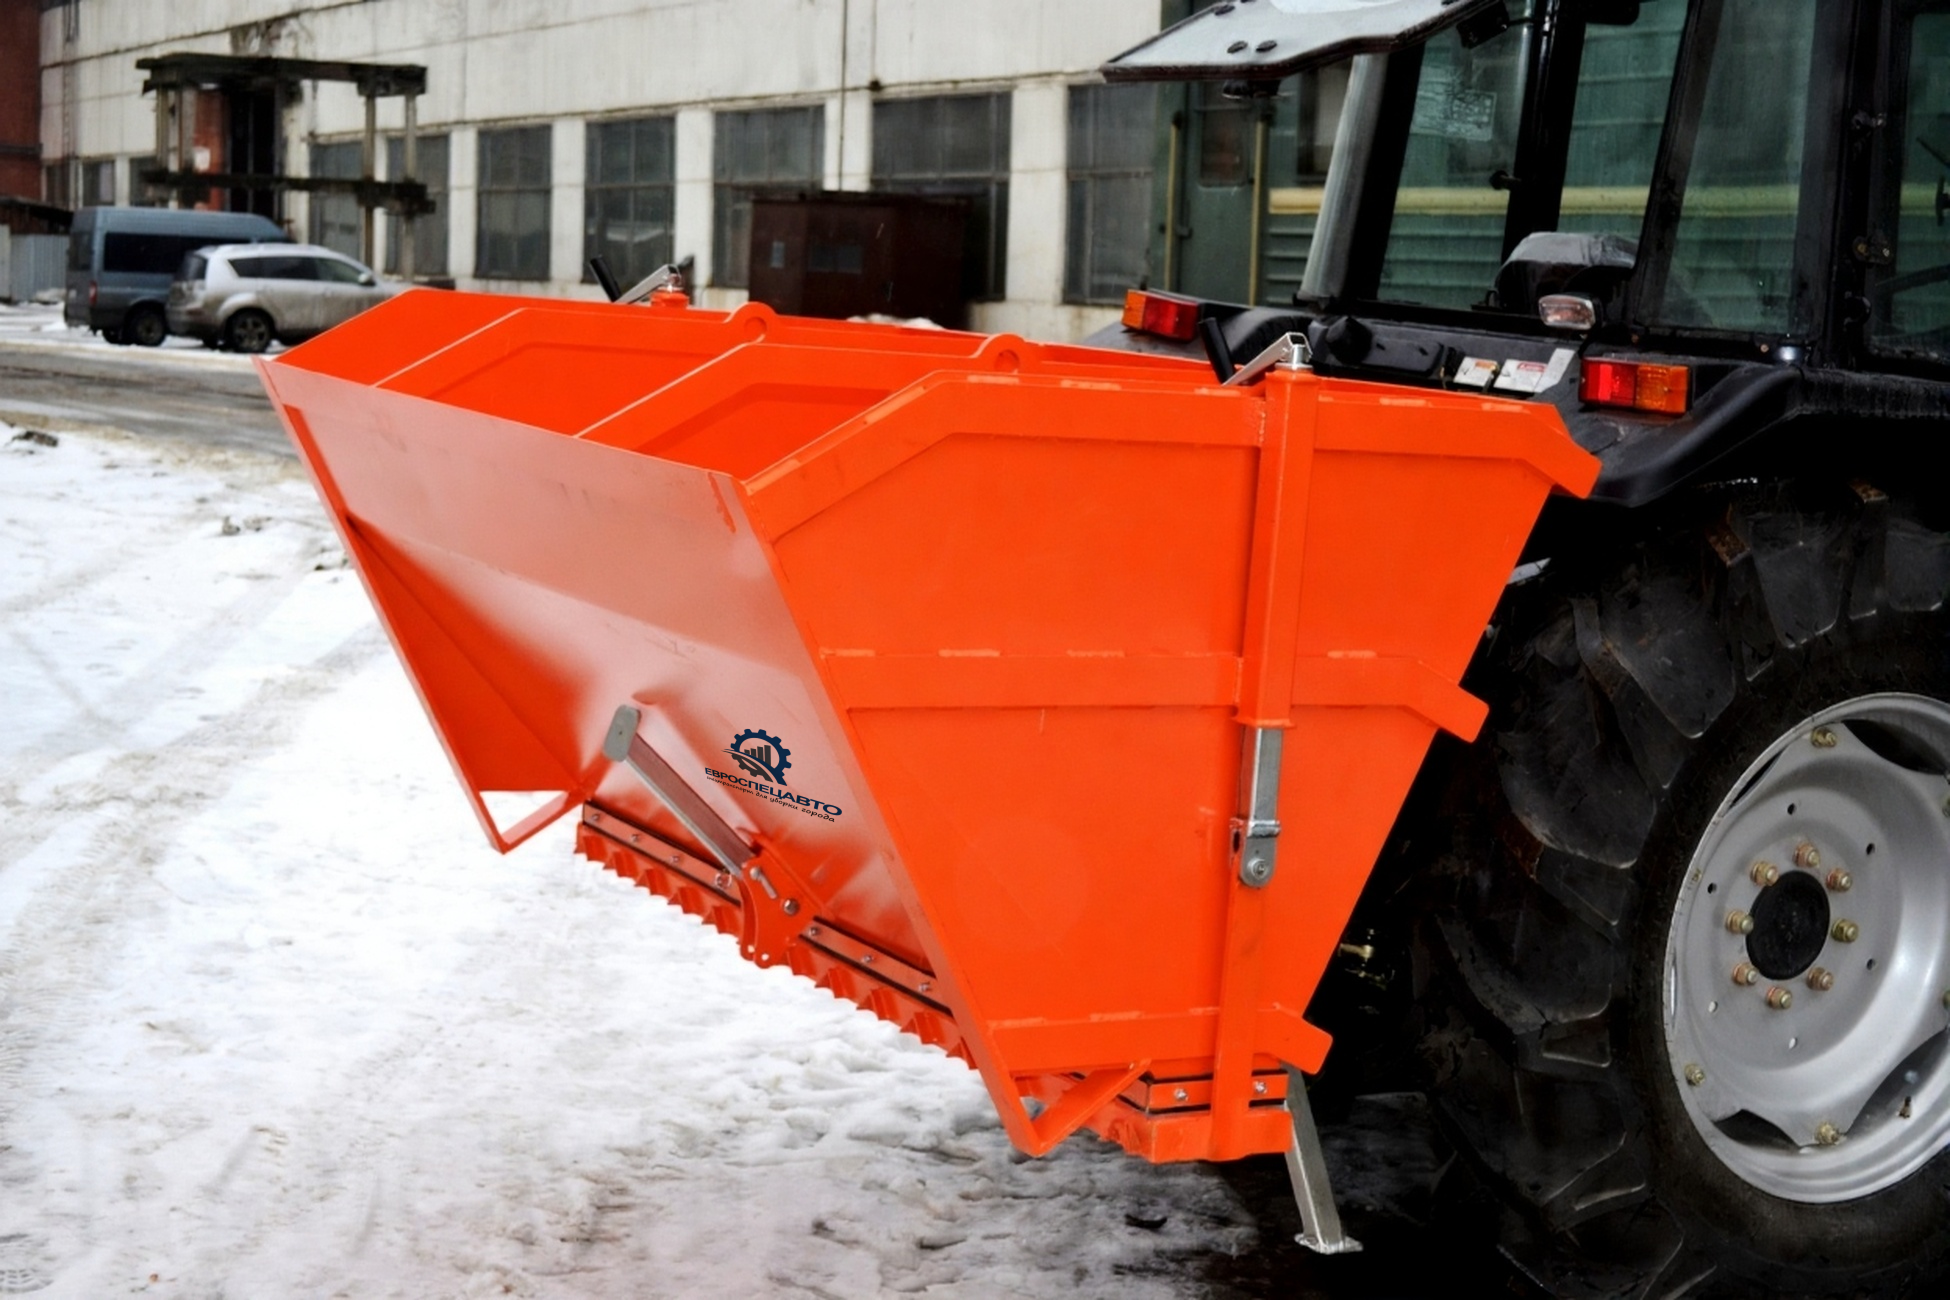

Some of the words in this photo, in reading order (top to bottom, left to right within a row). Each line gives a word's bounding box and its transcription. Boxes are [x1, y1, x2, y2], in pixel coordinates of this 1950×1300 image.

[705, 767, 843, 816] ЕВРОСПЕЦАВТО
[769, 797, 798, 810] уборки
[801, 808, 835, 822] города
